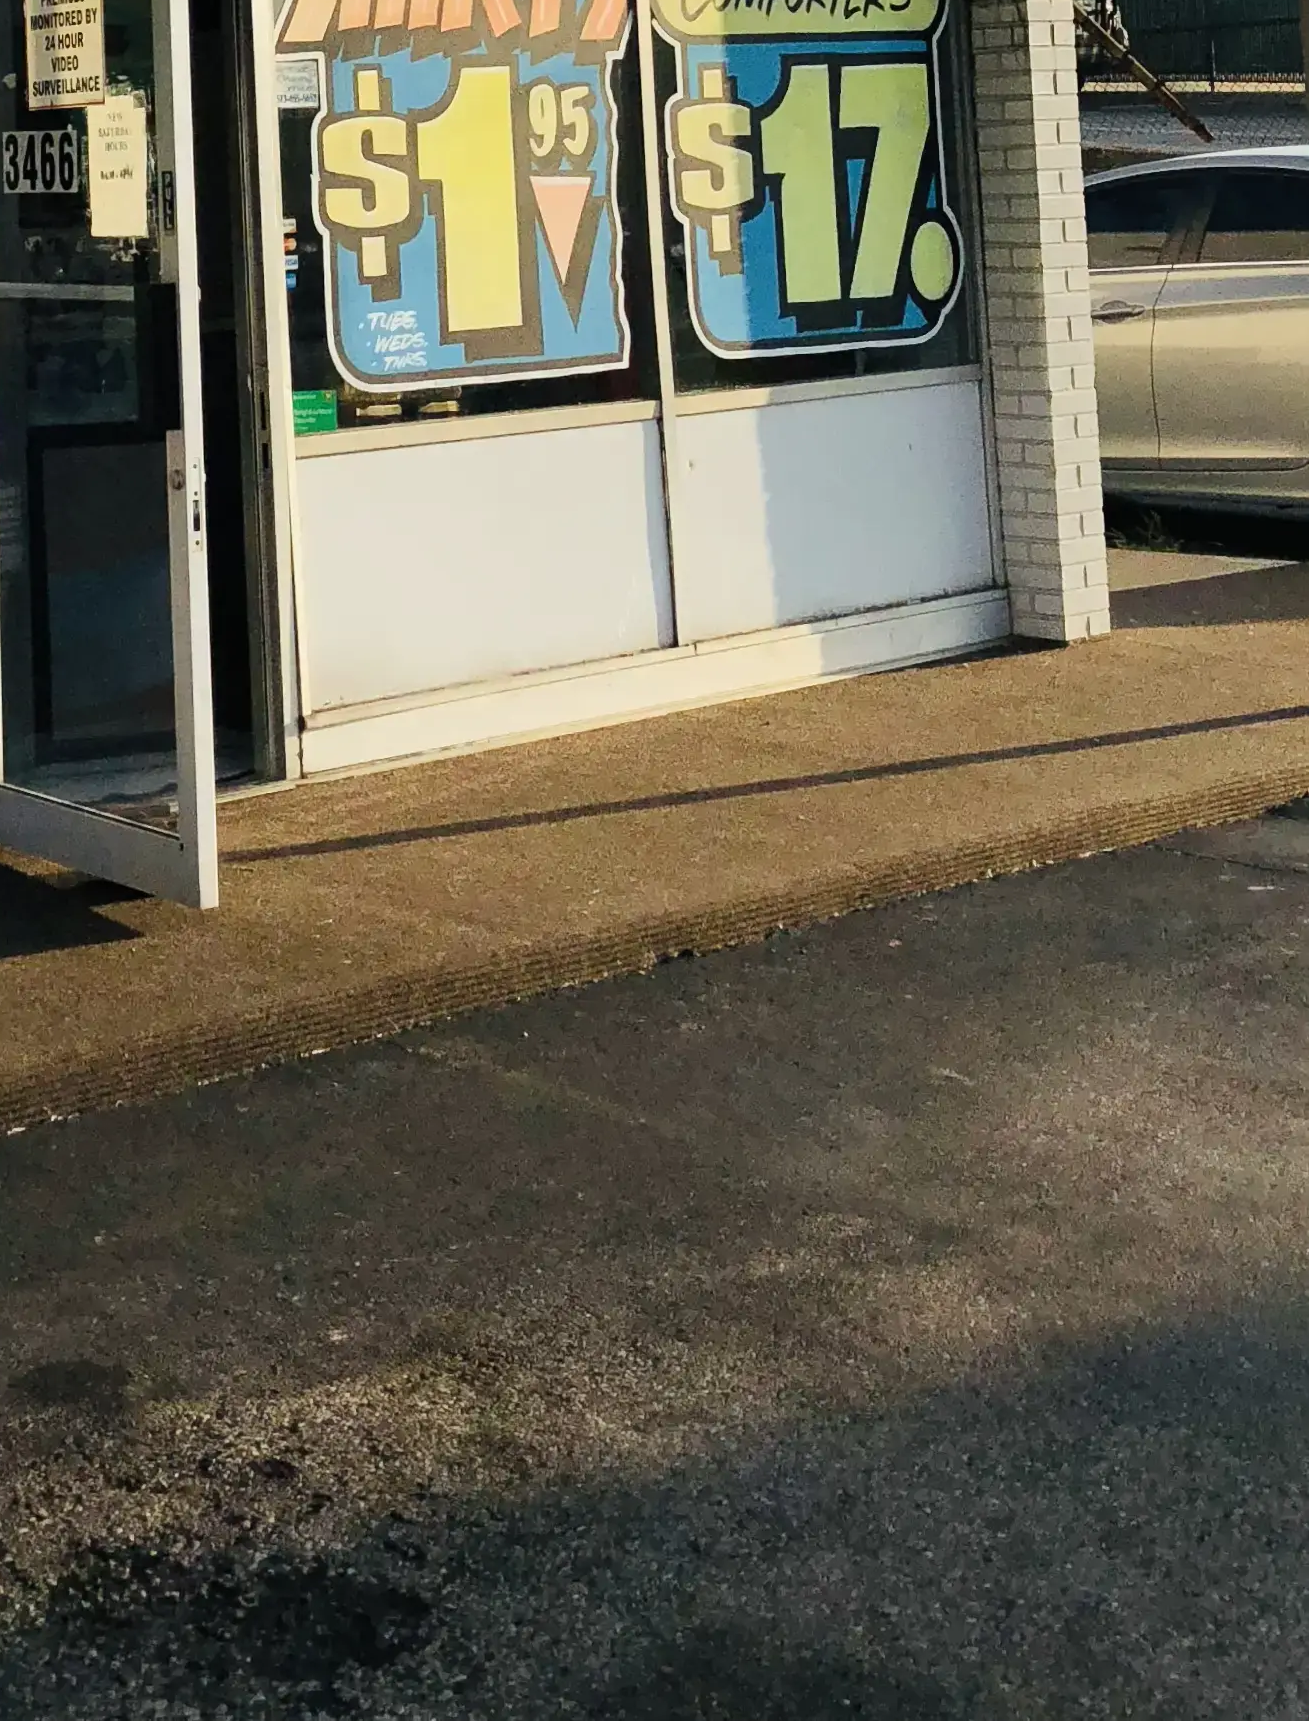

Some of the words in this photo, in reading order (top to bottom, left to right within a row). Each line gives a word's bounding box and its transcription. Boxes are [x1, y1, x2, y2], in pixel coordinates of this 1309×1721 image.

[30, 11, 83, 32] MONITORED
[85, 8, 98, 25] BY
[45, 35, 56, 51] 24
[57, 31, 84, 50] HOUR
[51, 54, 79, 73] VIDEO
[32, 75, 100, 98] SURVEILLANCE
[5, 132, 74, 191] 3466
